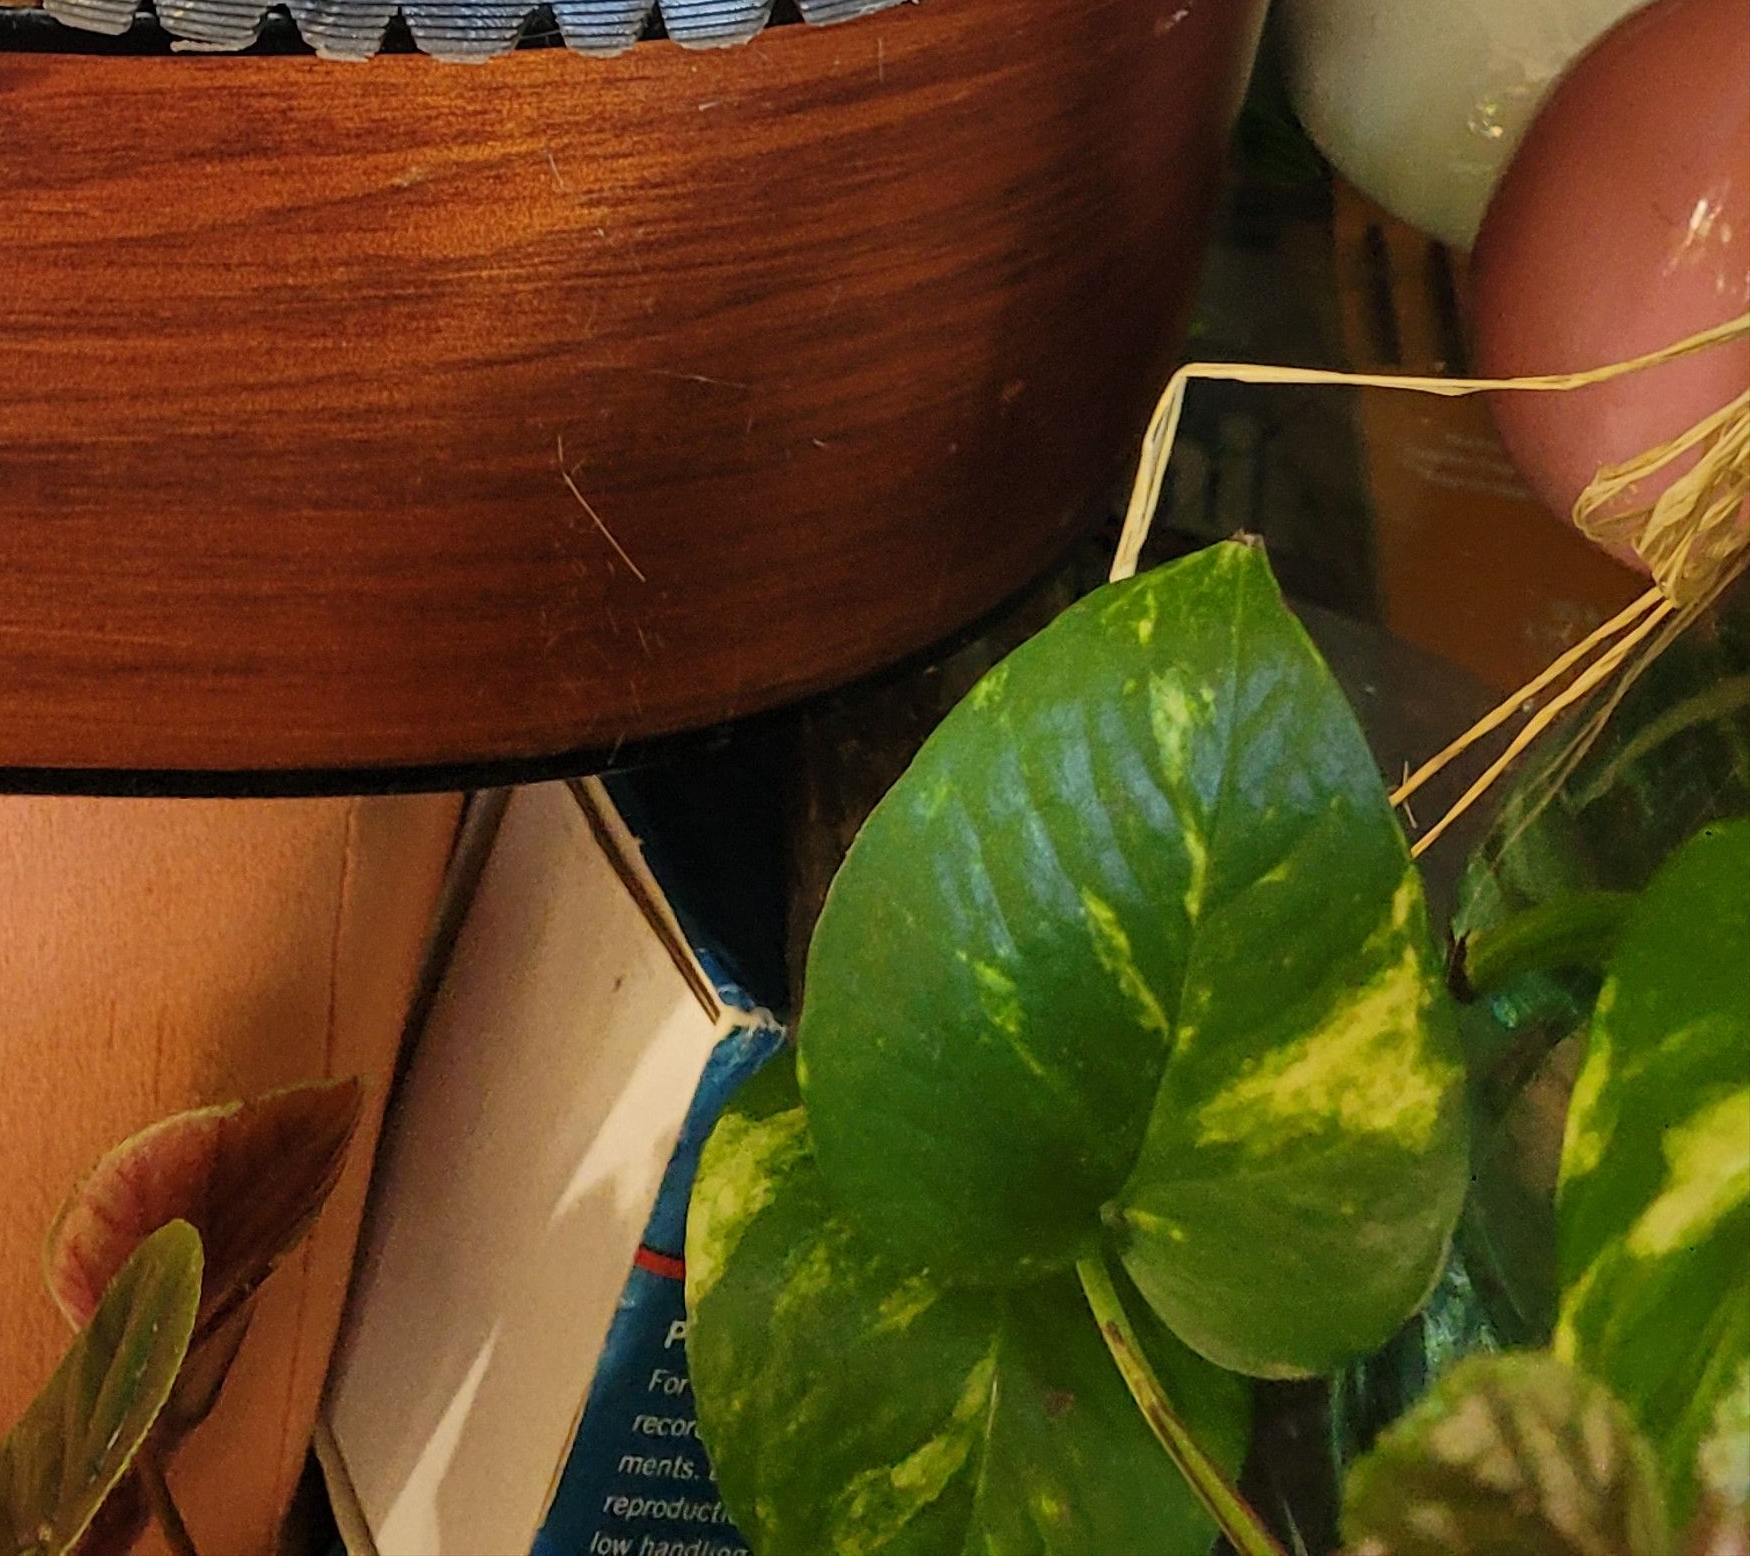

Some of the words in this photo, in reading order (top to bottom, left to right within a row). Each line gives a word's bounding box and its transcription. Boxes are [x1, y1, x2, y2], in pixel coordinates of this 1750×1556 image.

[632, 1414, 703, 1440] recor
[617, 1455, 700, 1481] ments.
[590, 1530, 634, 1556] low
